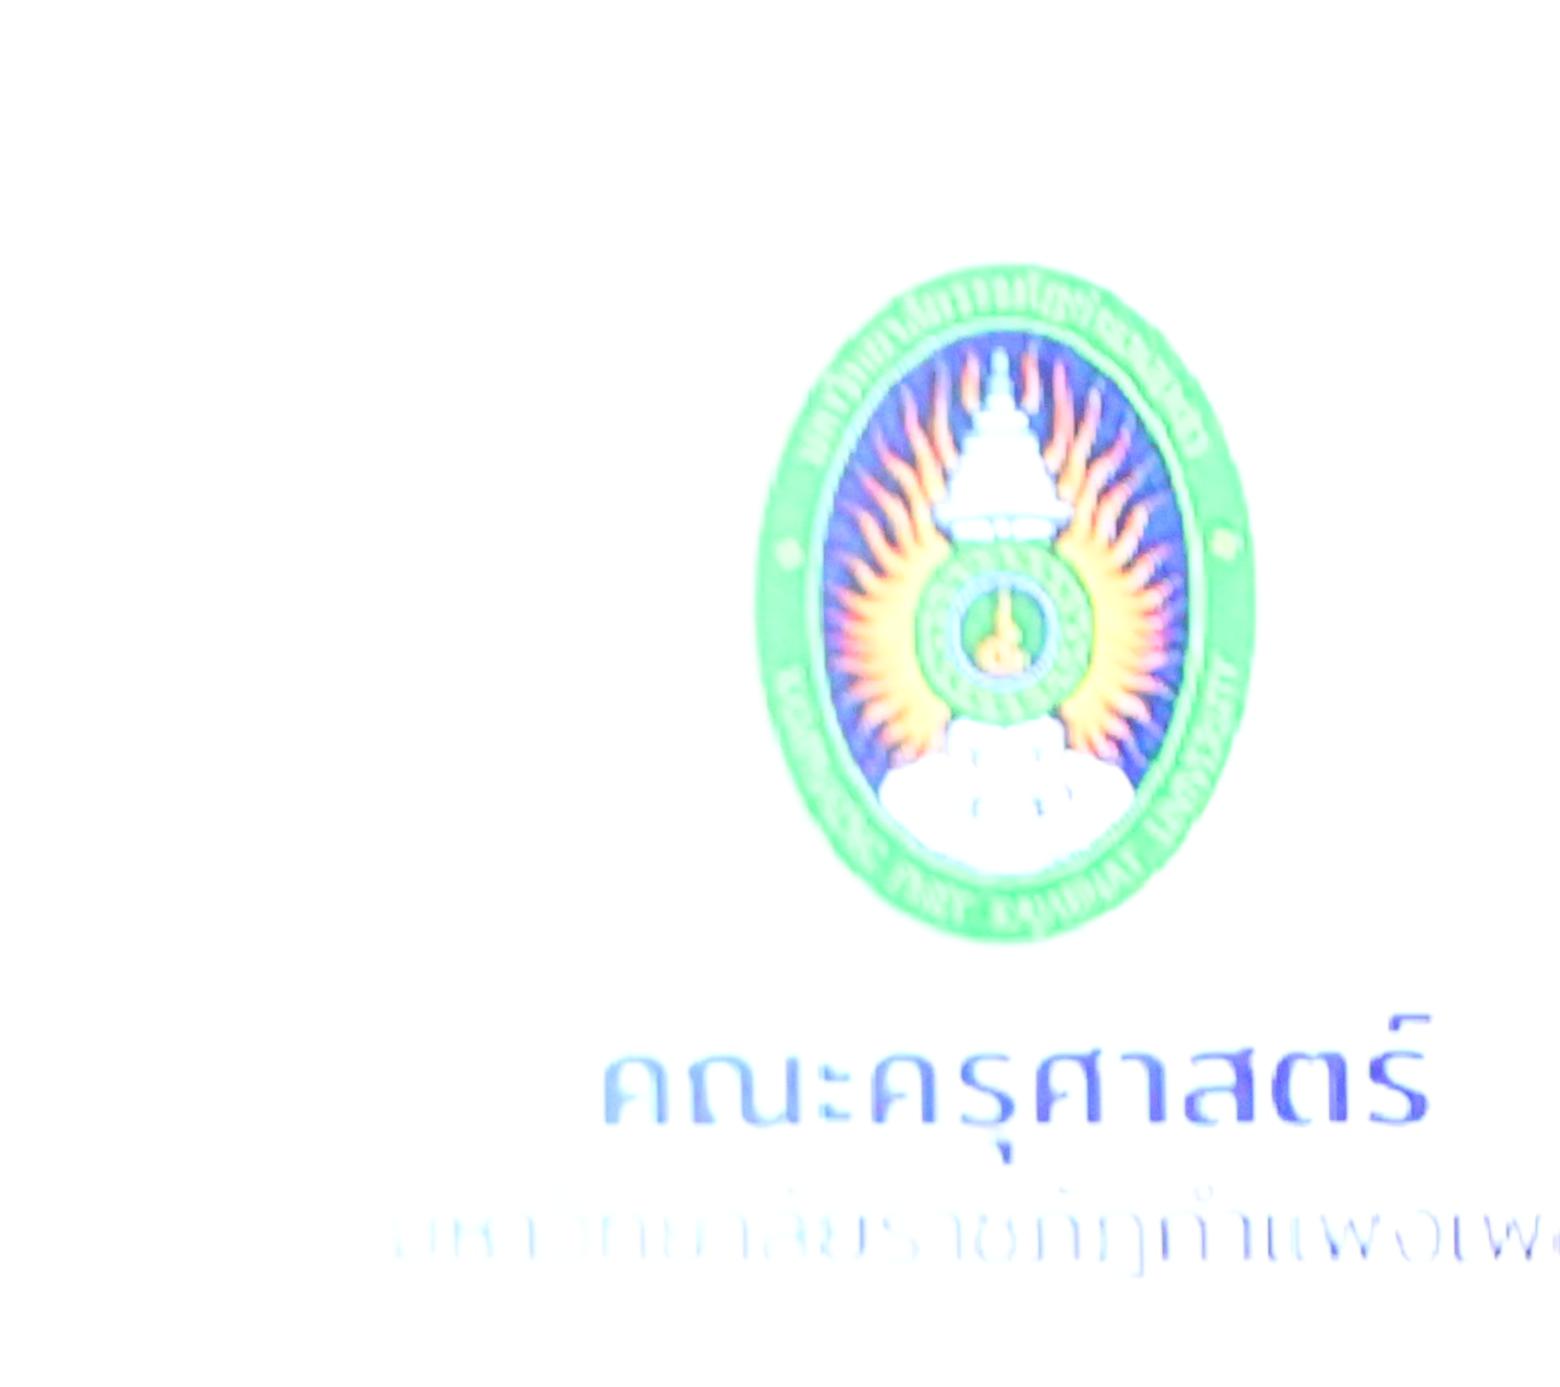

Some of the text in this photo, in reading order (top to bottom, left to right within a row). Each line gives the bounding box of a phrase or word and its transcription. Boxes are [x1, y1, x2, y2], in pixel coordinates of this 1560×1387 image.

[602, 1011, 1433, 1167] คณะครุศาสตร์
